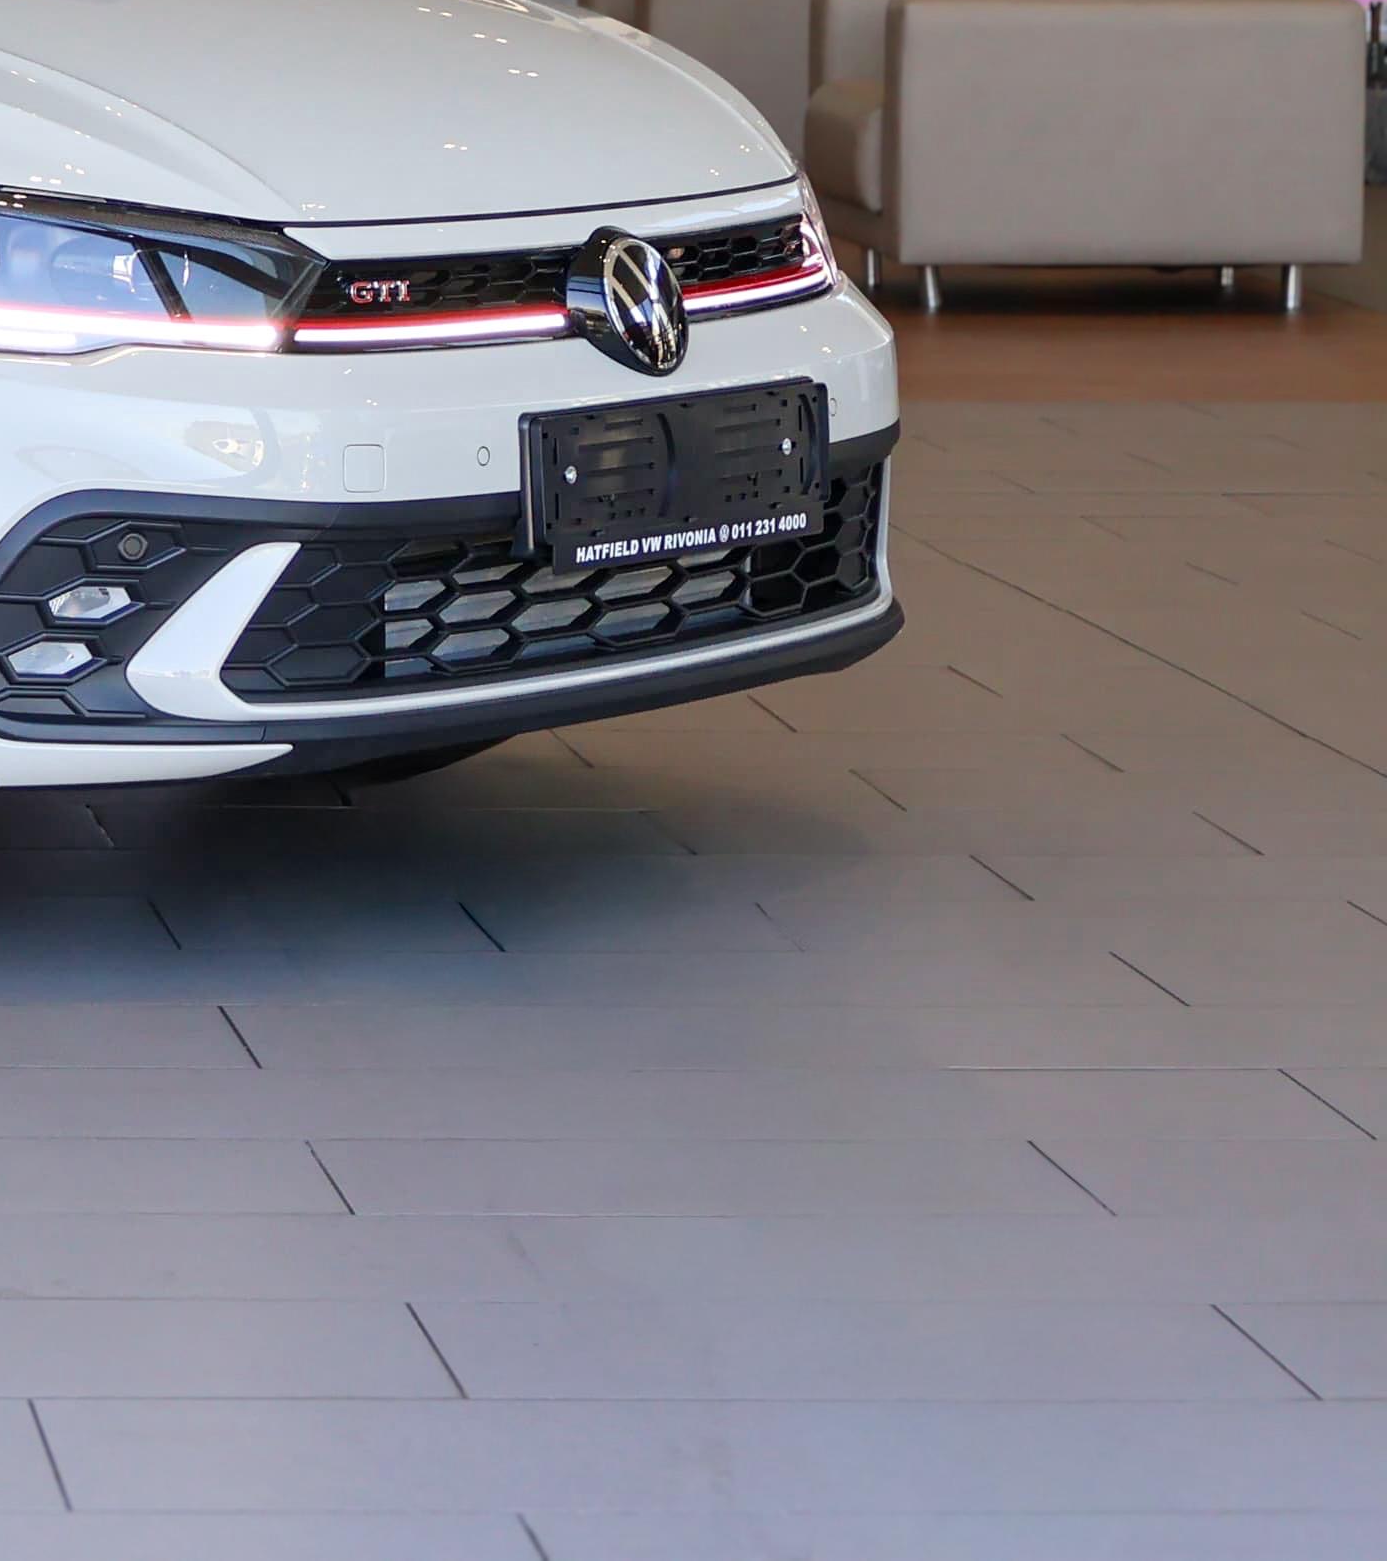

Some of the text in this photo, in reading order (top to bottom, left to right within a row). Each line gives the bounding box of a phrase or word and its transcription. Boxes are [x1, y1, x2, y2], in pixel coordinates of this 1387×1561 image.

[350, 279, 411, 305] GTI
[575, 539, 640, 564] HATFIELD
[642, 536, 662, 554] VW
[664, 527, 716, 551] RIVONIA
[731, 521, 753, 540] 011
[755, 518, 776, 536] 231
[778, 512, 807, 532] 4000
